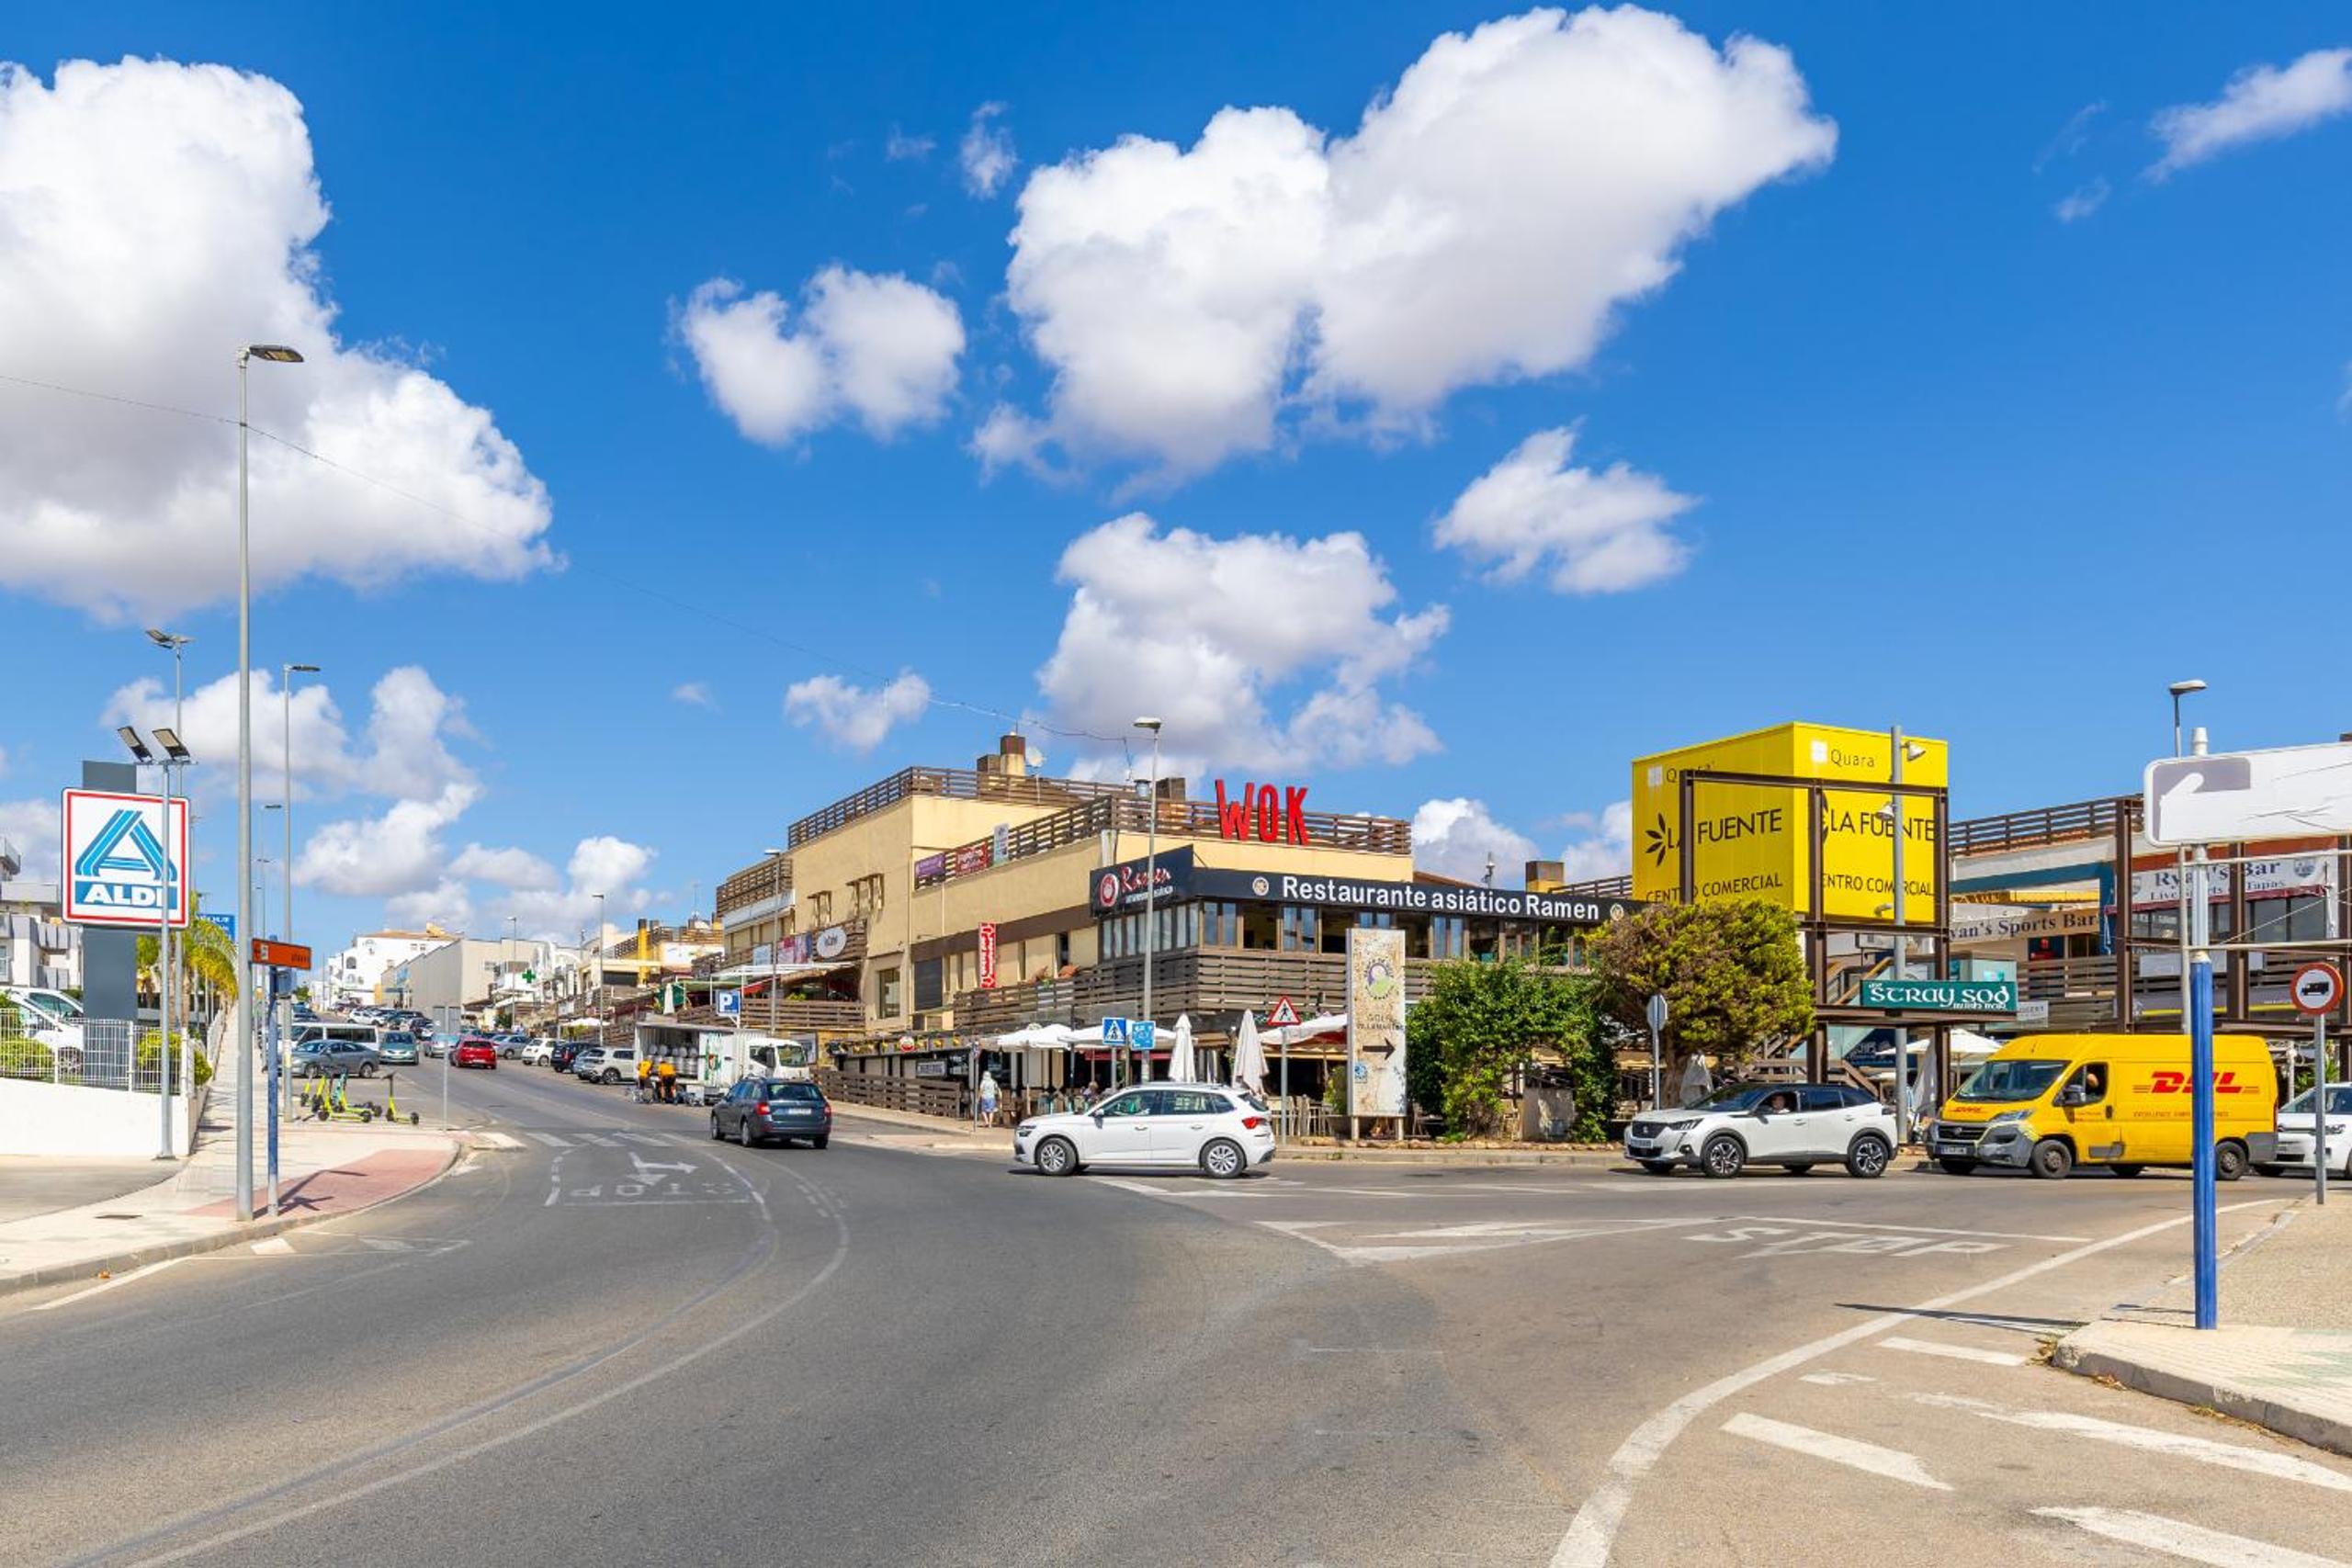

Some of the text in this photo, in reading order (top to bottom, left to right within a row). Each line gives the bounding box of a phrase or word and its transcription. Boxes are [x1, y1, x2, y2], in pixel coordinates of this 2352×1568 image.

[1831, 749, 1875, 768] Quara
[1215, 779, 1309, 846] WOK
[1698, 808, 1782, 845] FUENTE
[1830, 808, 1856, 834] LA
[1120, 866, 1171, 894] Raen
[1645, 872, 1783, 904] CENTO COMERCIAL
[1822, 873, 1934, 897] ENTRO COMRCIAL
[83, 883, 163, 908] ALDI
[1283, 875, 1599, 920] Restaurante asiático Ramen
[1949, 912, 2097, 942] yan's Sports Bar
[1682, 1226, 2014, 1259] STOP
